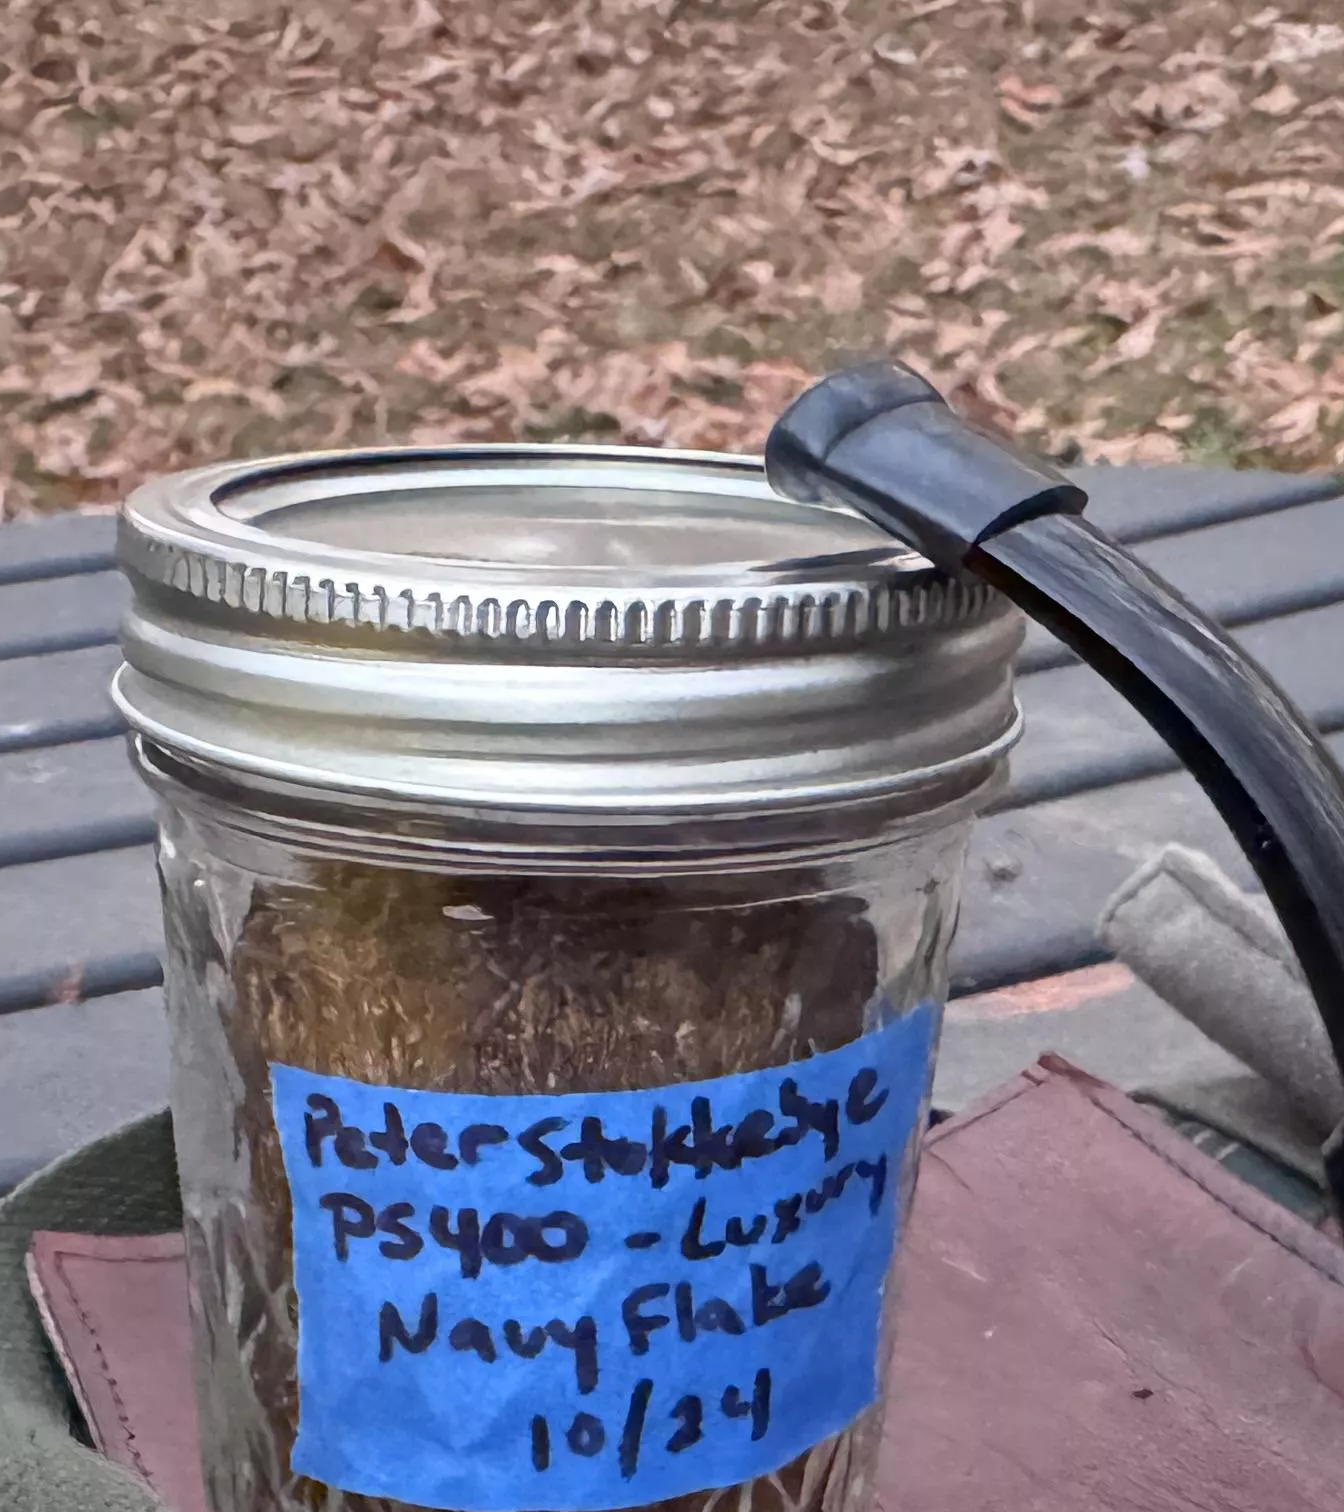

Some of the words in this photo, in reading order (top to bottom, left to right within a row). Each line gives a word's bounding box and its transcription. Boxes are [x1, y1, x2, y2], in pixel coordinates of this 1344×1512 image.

[303, 1093, 509, 1170] Peter
[318, 1192, 589, 1280] PS400
[681, 1153, 887, 1260] Luxury
[377, 1292, 598, 1394] Navy
[621, 1261, 831, 1355] Flake
[530, 1369, 772, 1482] 10/24
